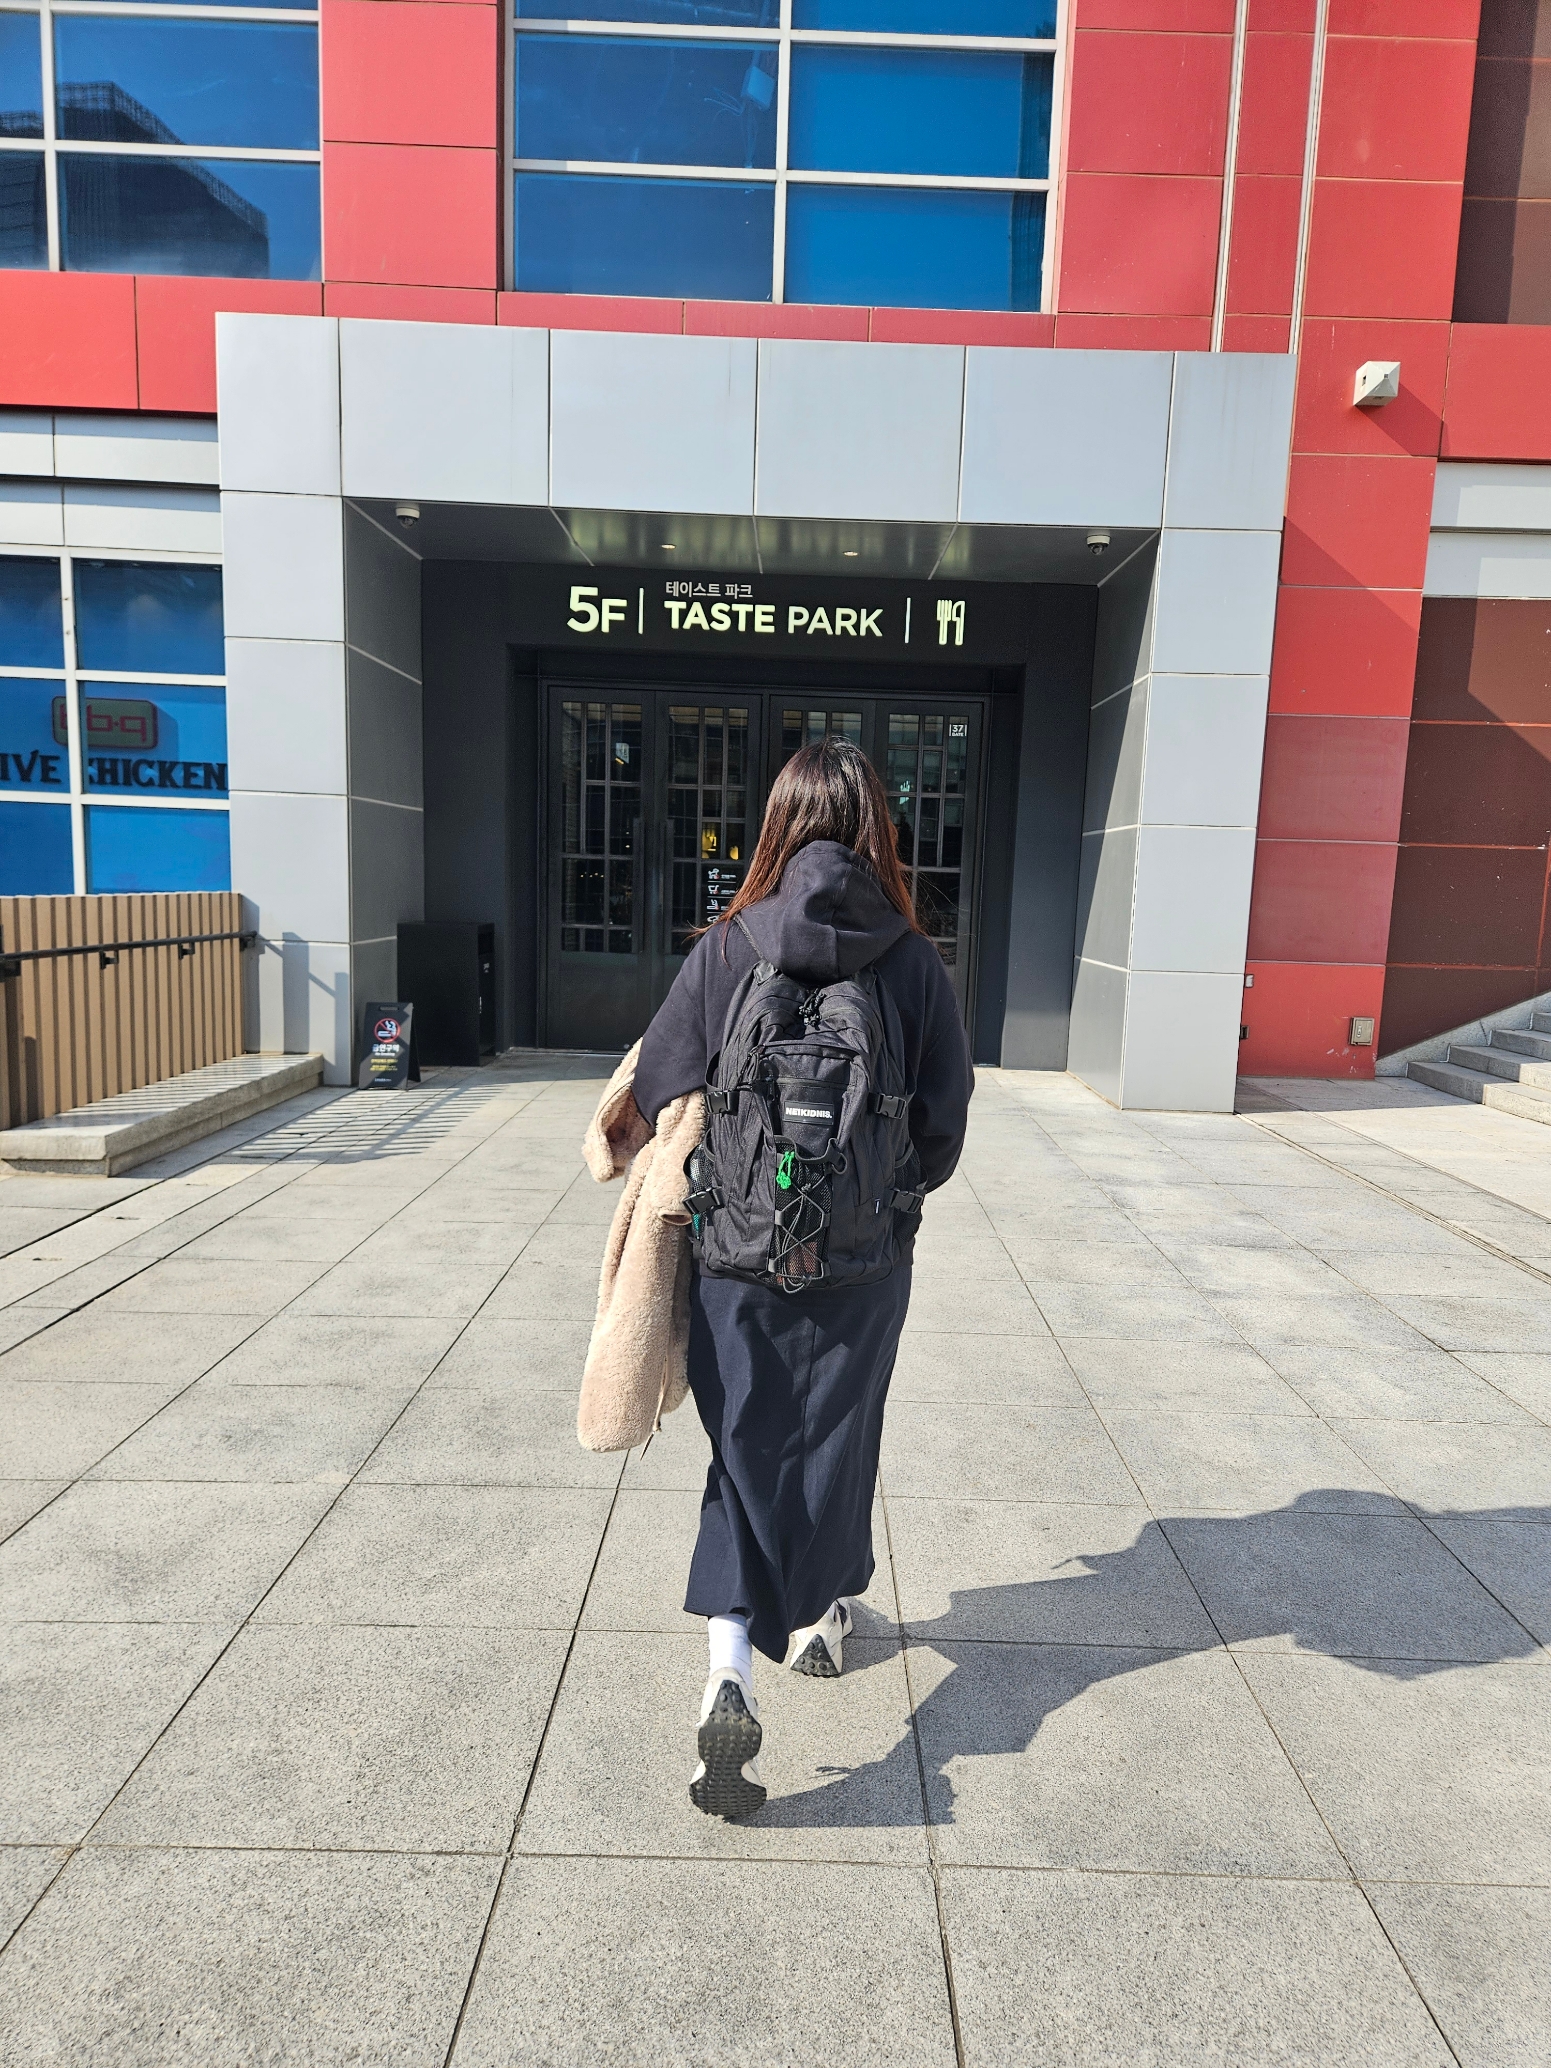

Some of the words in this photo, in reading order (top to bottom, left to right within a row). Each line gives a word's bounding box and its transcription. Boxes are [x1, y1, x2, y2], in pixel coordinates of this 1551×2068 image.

[665, 581, 721, 597] 테이스트
[725, 583, 753, 599] 파크
[567, 586, 627, 633] 5F
[664, 600, 775, 633] TASTE
[788, 606, 883, 637] PARK
[952, 724, 964, 732] 37
